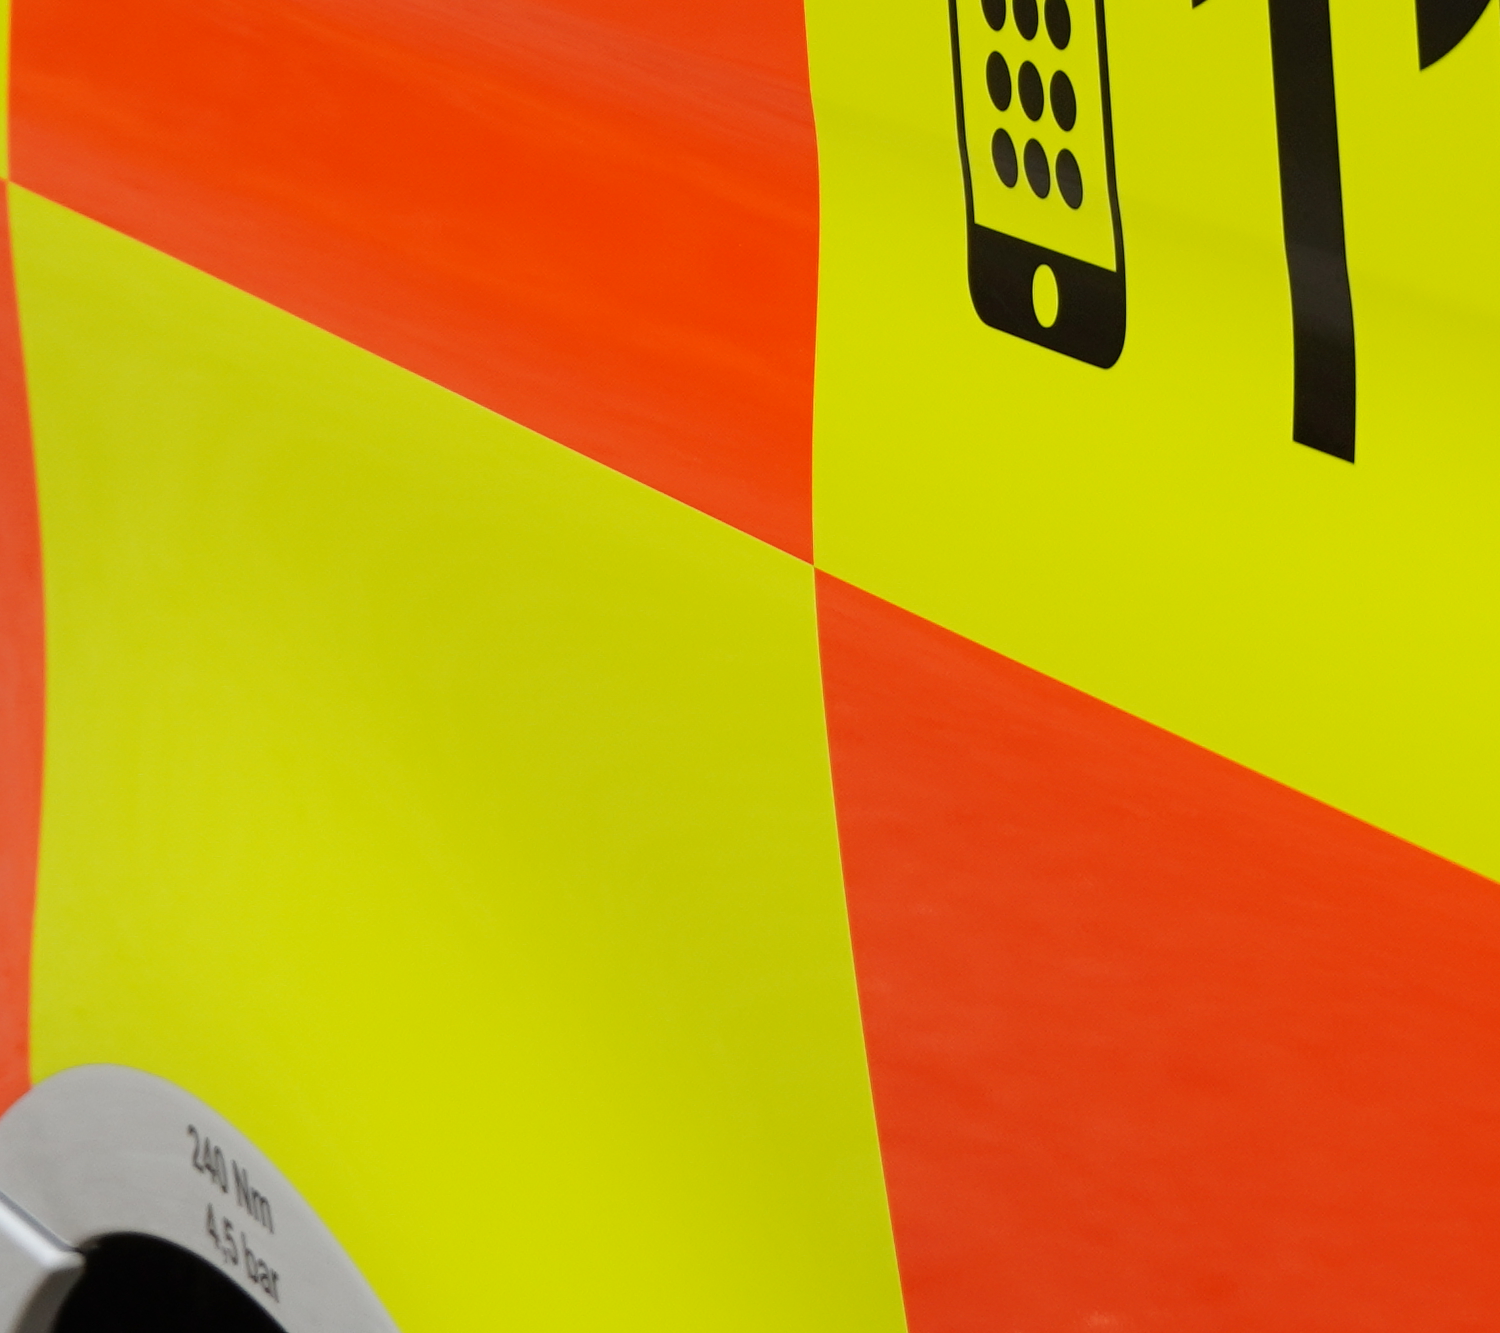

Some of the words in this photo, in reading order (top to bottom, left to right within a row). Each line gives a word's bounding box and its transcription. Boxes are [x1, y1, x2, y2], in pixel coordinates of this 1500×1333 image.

[187, 1124, 229, 1194] 240
[232, 1159, 275, 1234] Nm
[206, 1202, 239, 1265] 4,5
[241, 1231, 280, 1303] bar
